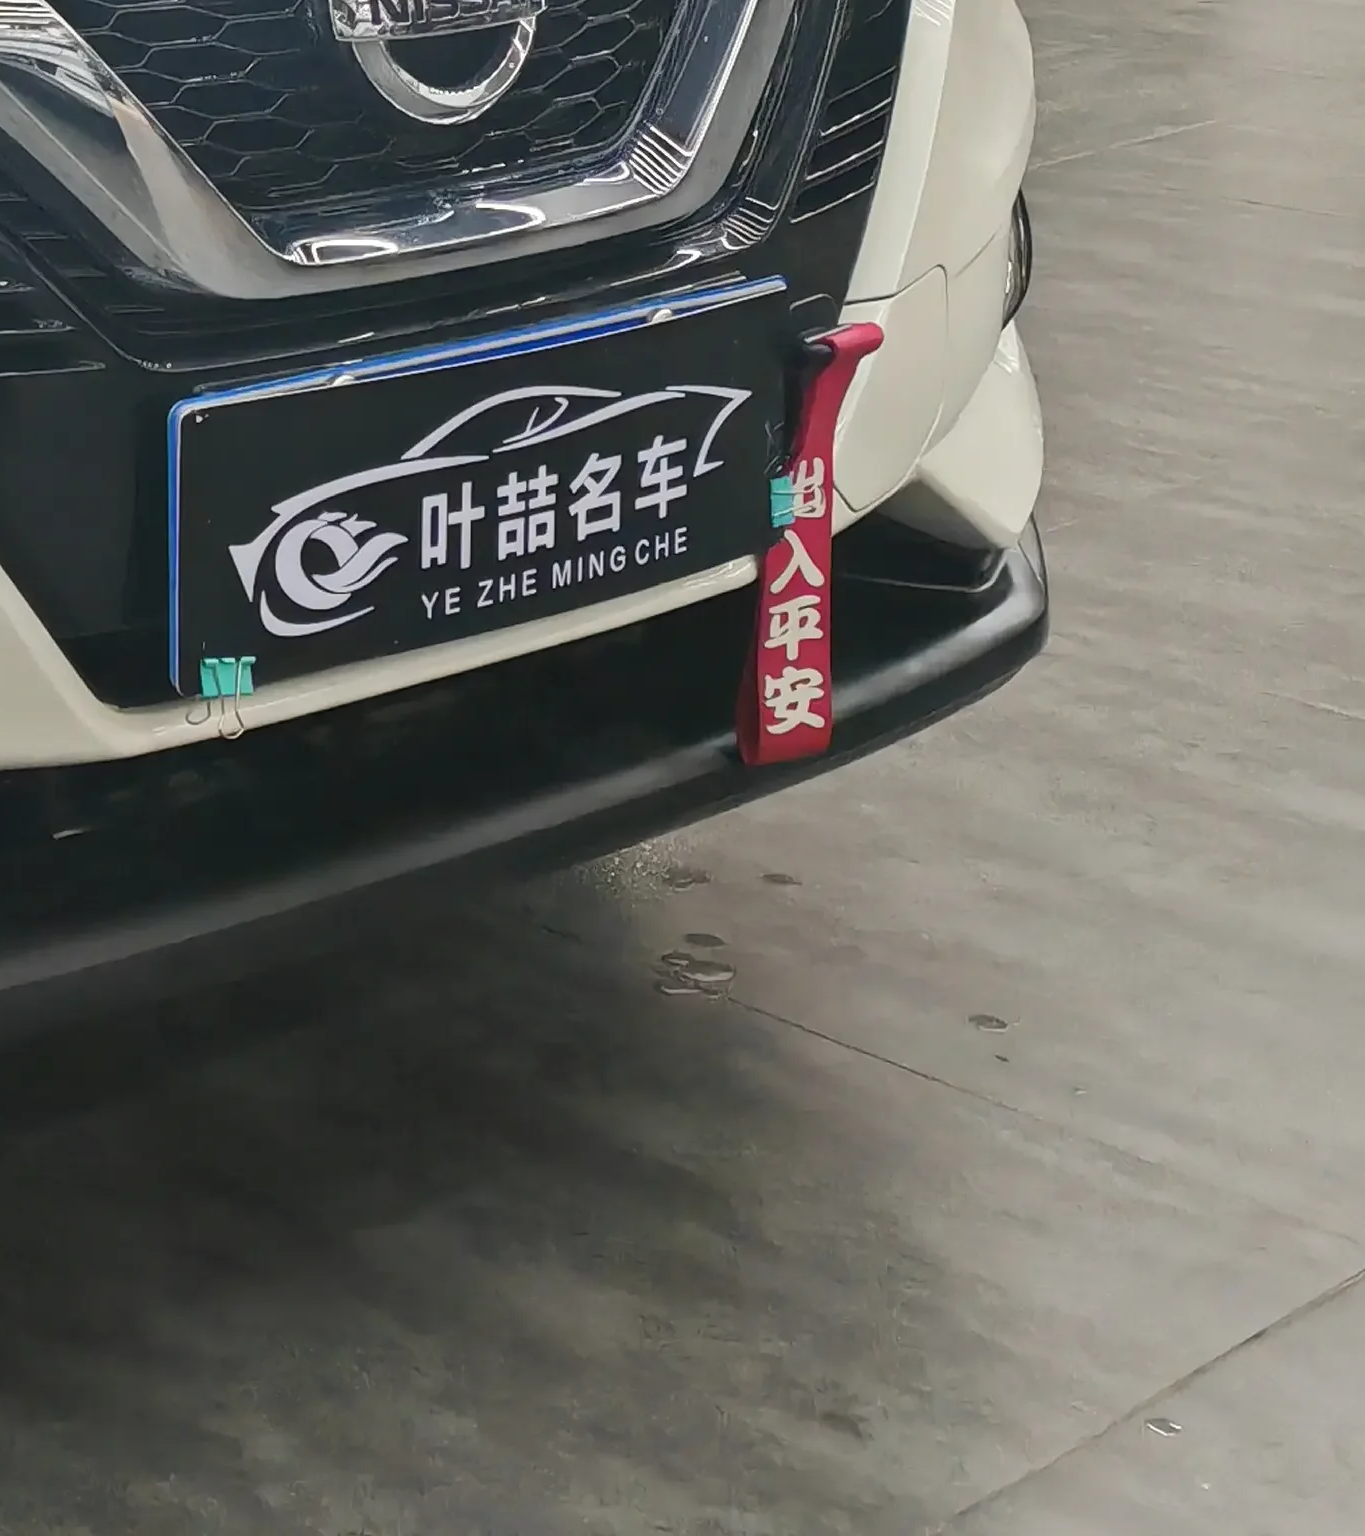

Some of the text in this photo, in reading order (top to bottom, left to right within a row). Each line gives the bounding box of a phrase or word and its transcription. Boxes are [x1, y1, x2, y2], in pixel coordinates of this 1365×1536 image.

[420, 434, 687, 569] 叶喆名车
[421, 526, 688, 619] YE ZHE MING CHE
